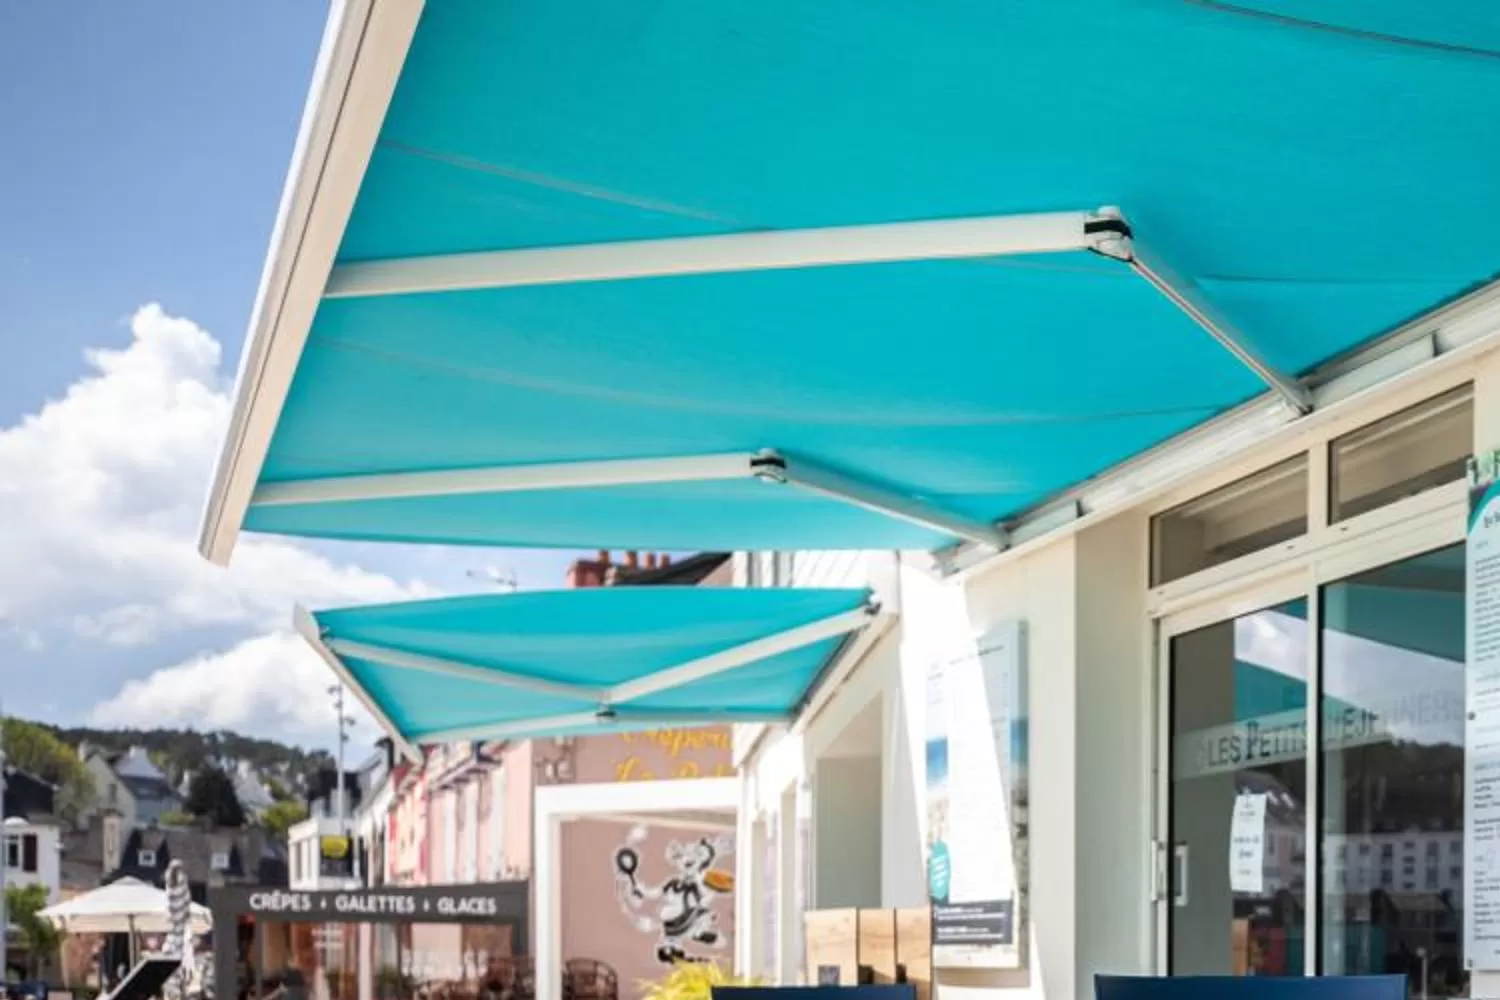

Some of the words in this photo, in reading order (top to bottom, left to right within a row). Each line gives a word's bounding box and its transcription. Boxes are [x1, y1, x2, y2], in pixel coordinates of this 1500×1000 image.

[1207, 735, 1242, 766] LES
[250, 889, 311, 912] CRÊPES
[335, 896, 416, 913] GALETTES
[437, 897, 497, 915] GLACES
